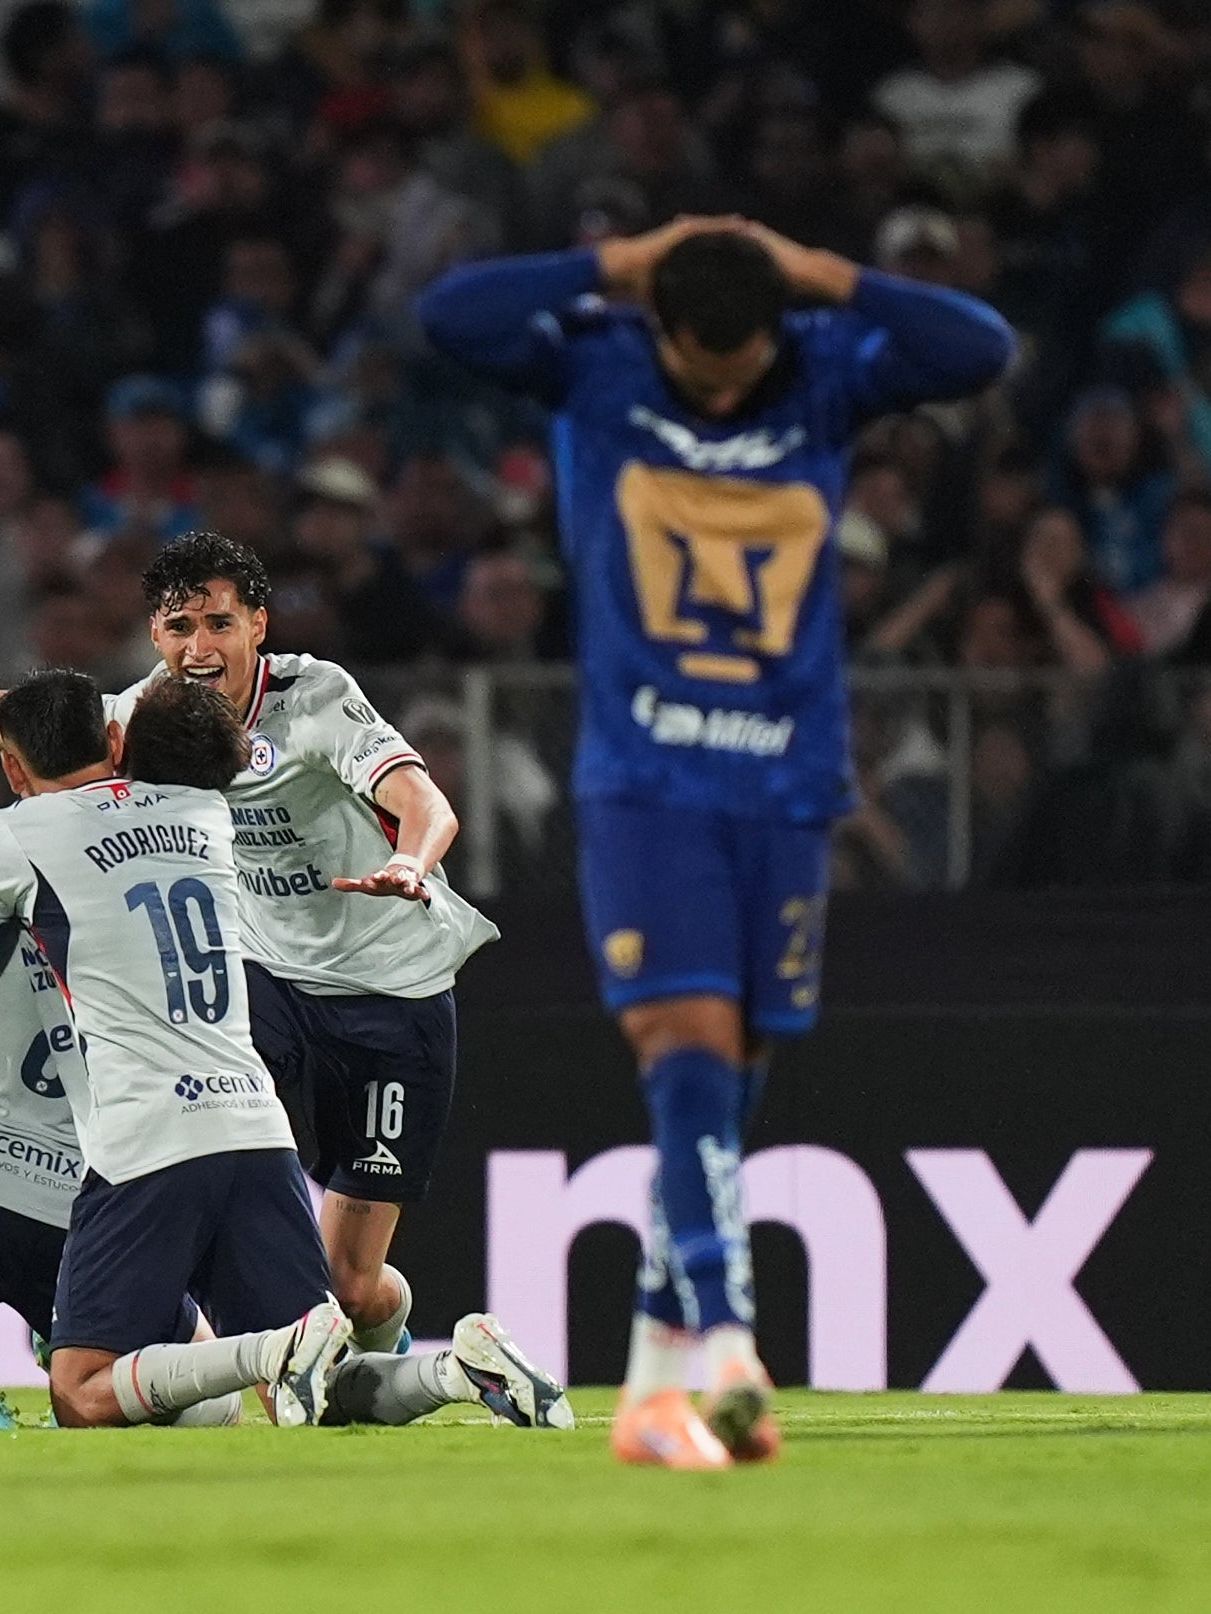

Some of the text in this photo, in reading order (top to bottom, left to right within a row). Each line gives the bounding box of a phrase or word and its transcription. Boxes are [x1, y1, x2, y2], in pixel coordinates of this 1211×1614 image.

[96, 793, 170, 812] PIMA
[231, 806, 292, 826] MENTO
[84, 824, 210, 874] RODRIGUEZ
[124, 877, 230, 1025] 19
[205, 1073, 268, 1094] cemix
[364, 1080, 405, 1140] 16
[352, 1161, 403, 1176] PIRMA
[24, 1170, 32, 1179] Y
[33, 1174, 79, 1192] ESTUCO
